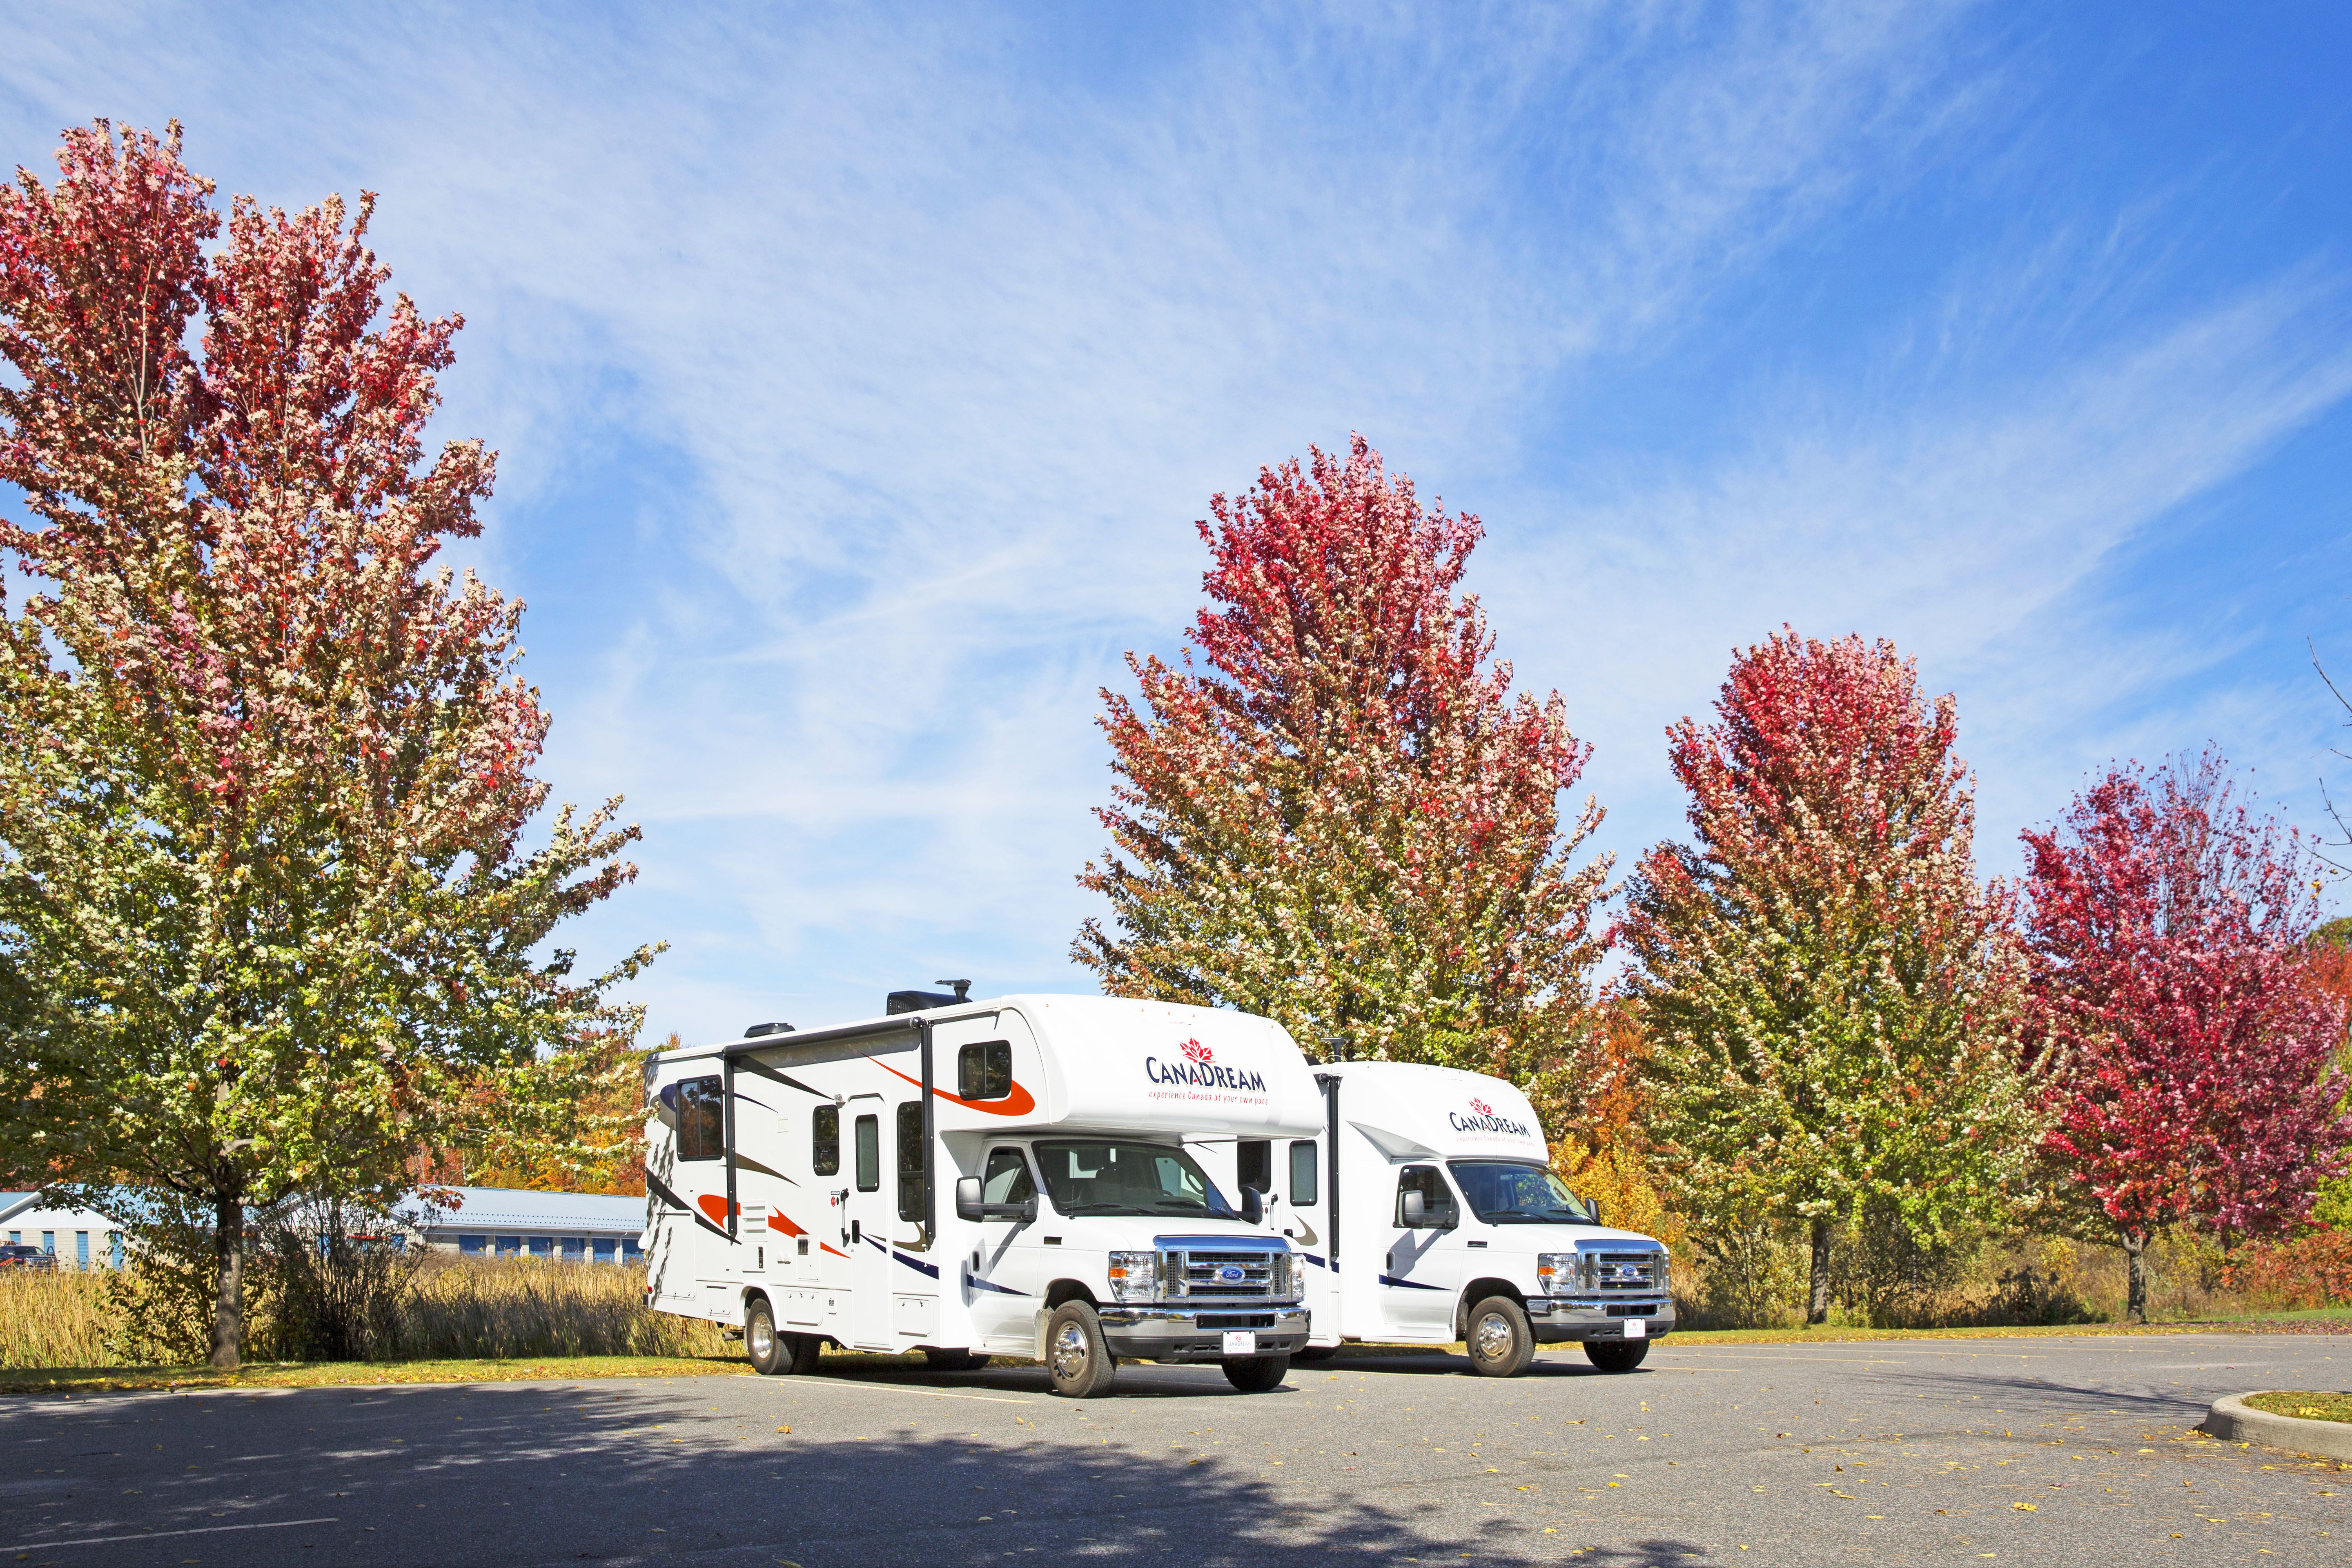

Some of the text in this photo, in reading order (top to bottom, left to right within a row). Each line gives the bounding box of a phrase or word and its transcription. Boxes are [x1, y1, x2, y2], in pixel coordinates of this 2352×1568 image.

[1149, 1091, 1186, 1100] experience
[1188, 1091, 1212, 1100] Canada
[1223, 1095, 1238, 1103] your
[1254, 1097, 1268, 1106] pace
